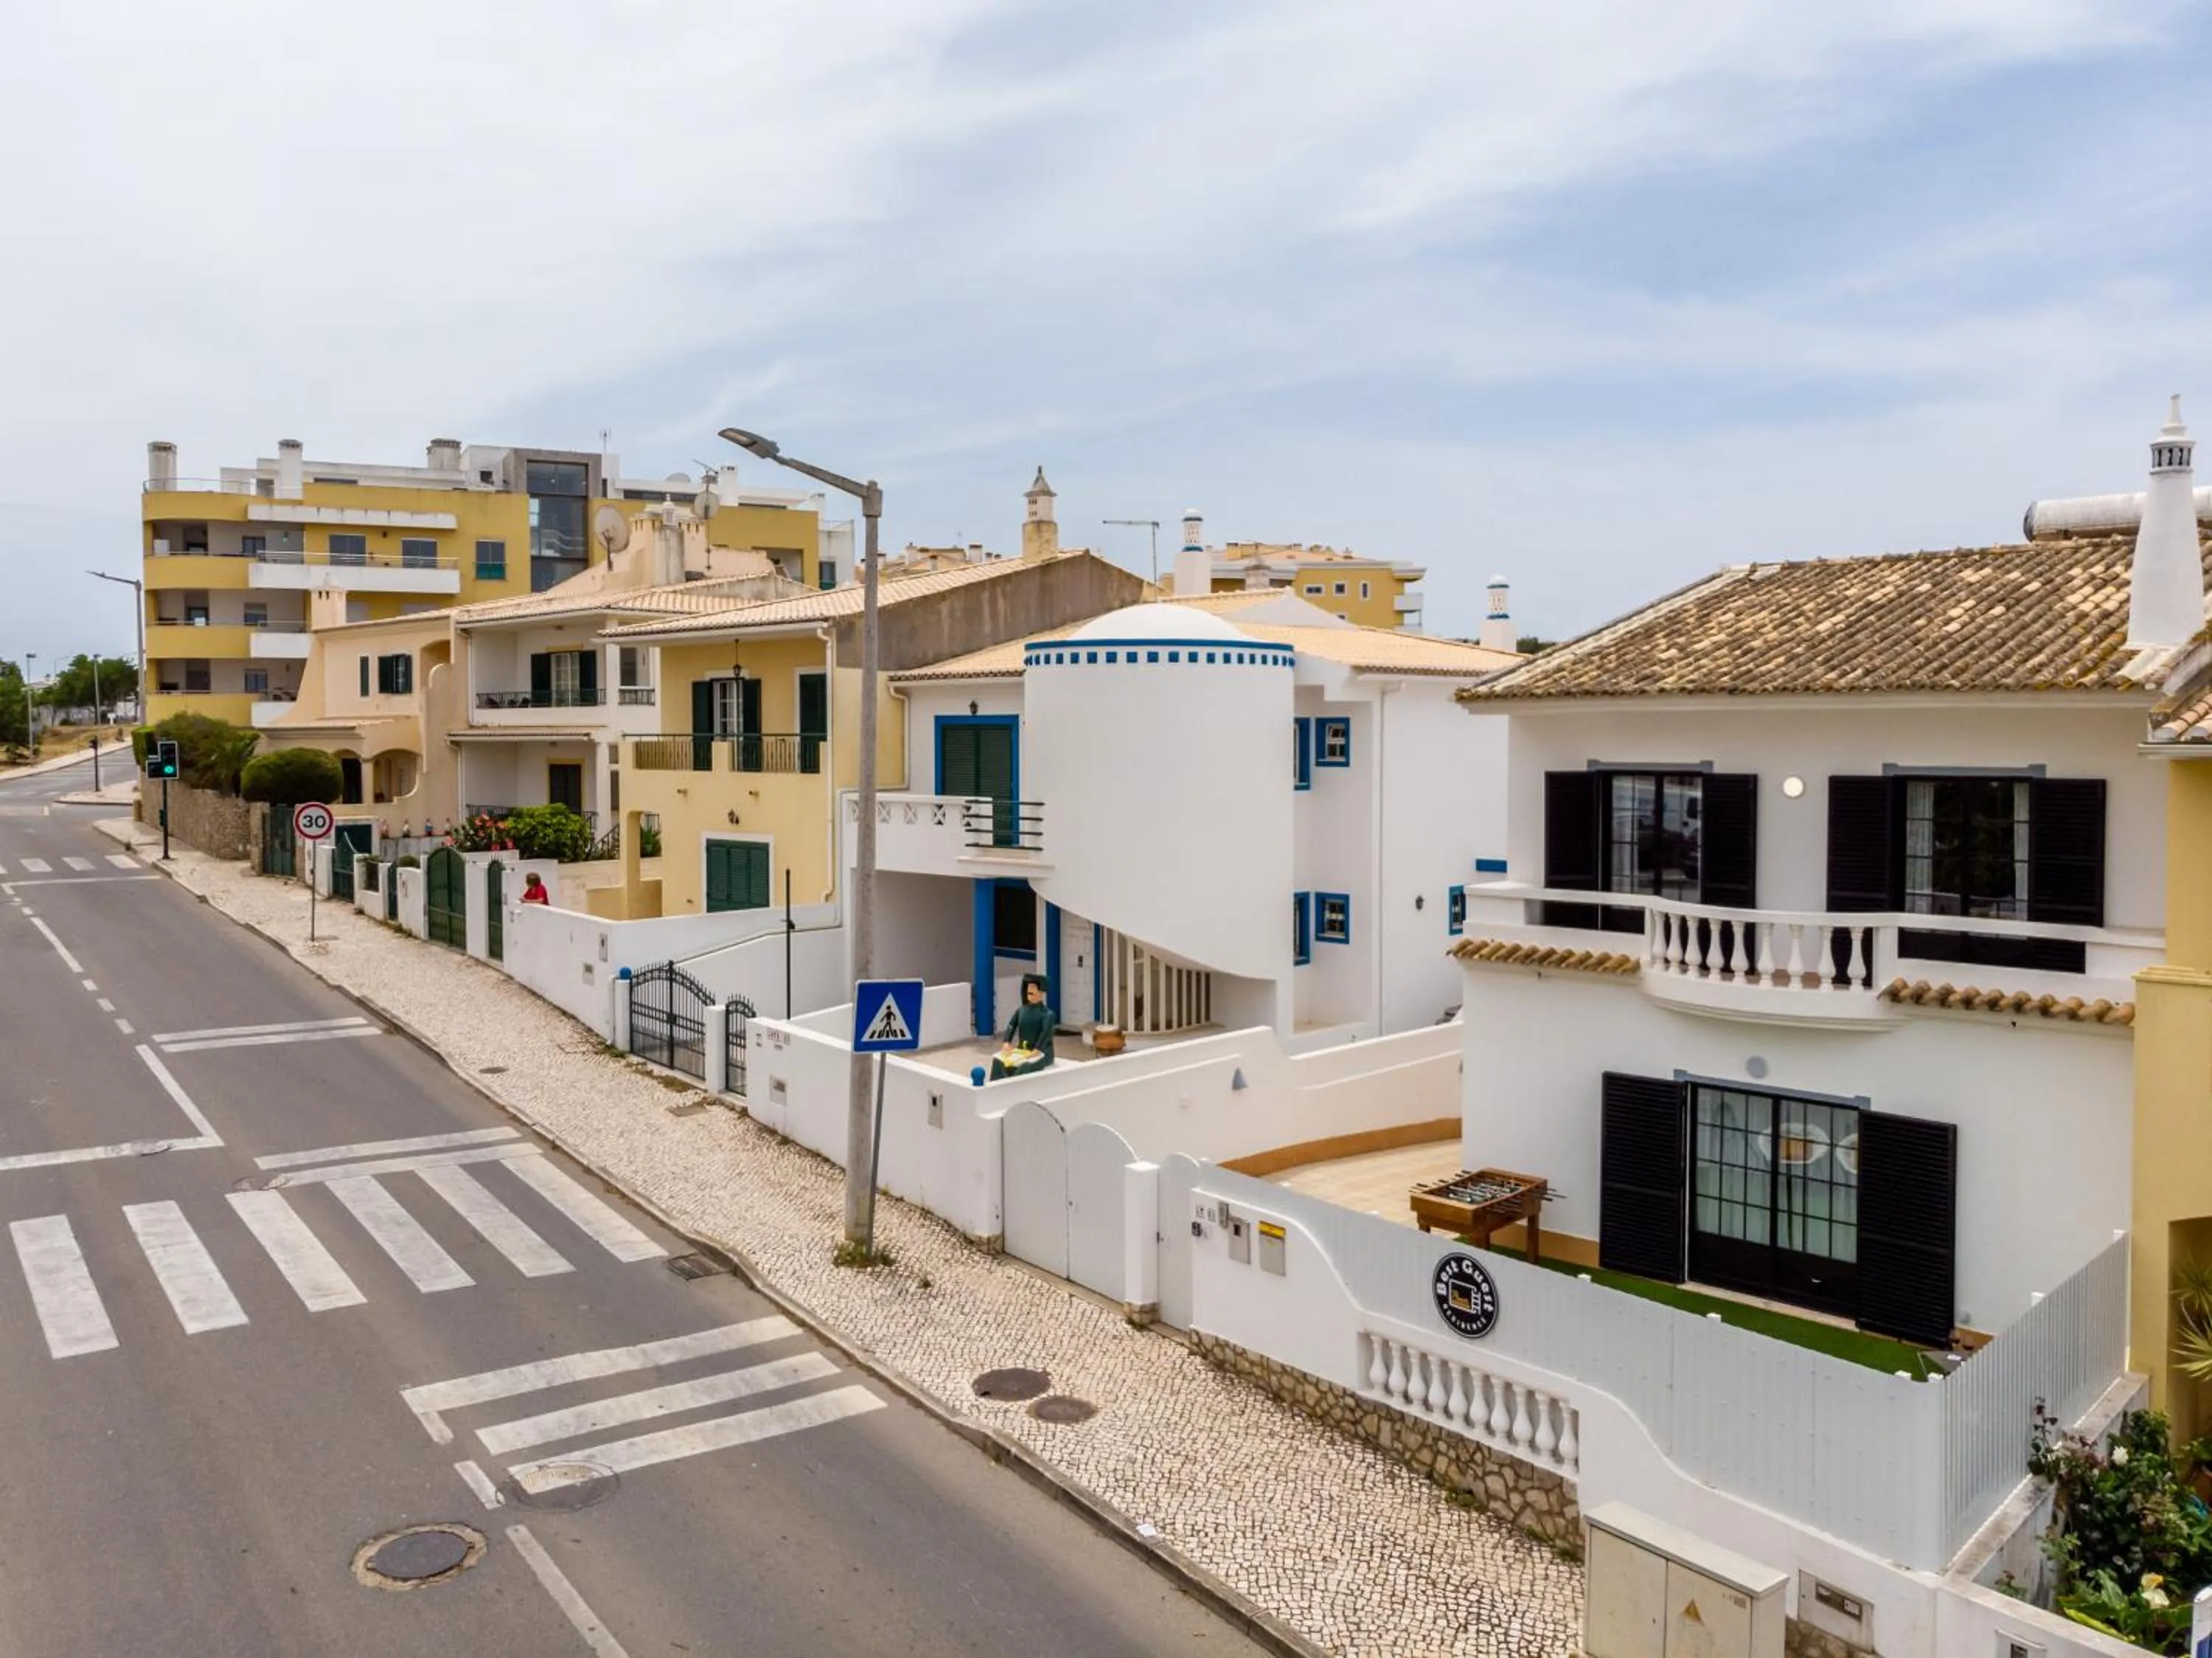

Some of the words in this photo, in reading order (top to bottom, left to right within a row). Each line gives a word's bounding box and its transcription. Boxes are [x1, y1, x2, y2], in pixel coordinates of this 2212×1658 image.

[303, 814, 326, 828] 30
[1436, 1260, 1459, 1296] Best
[1461, 1260, 1494, 1312] Guest
